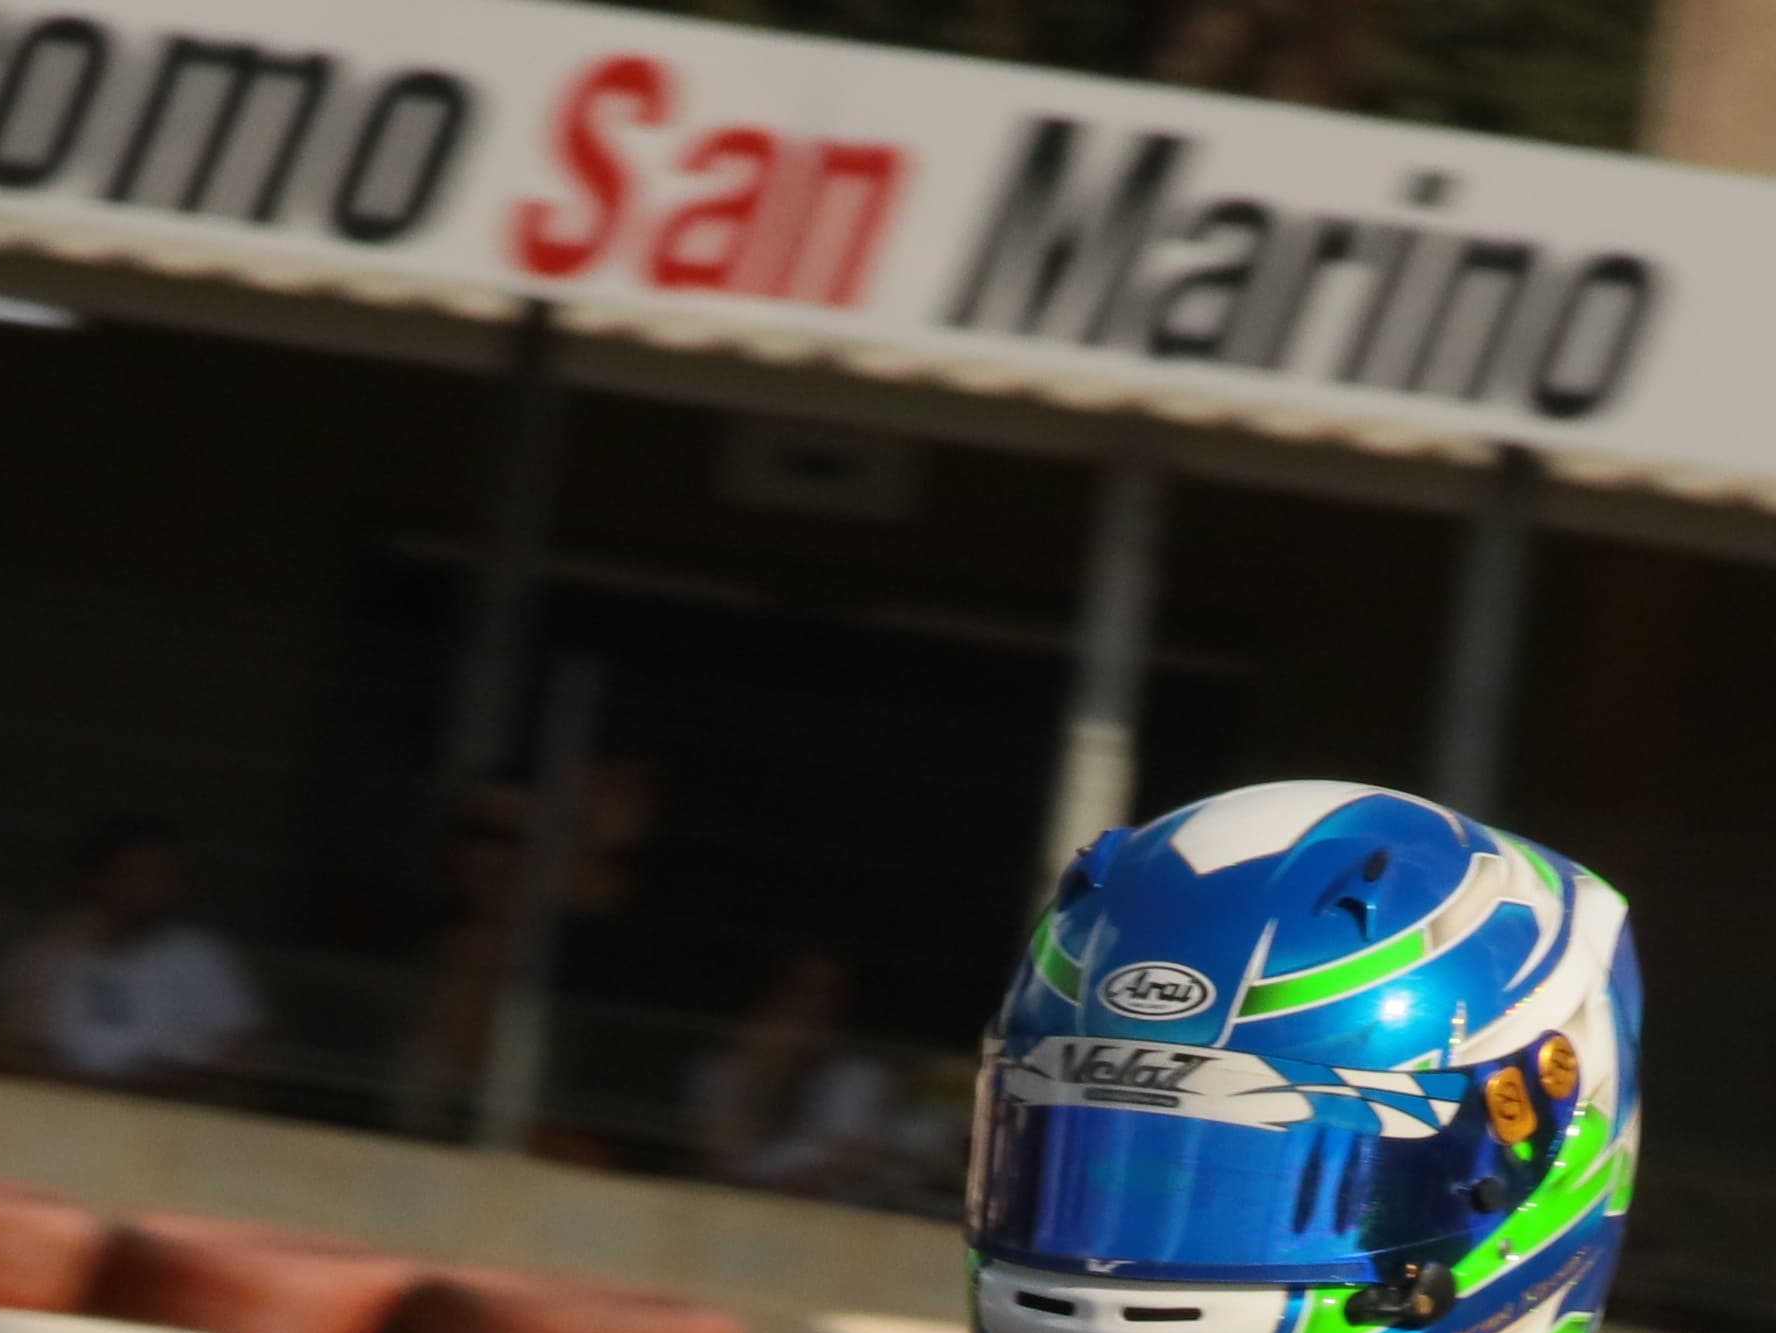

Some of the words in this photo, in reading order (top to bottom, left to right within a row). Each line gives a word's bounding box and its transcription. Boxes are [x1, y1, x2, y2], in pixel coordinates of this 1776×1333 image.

[509, 52, 914, 312] San
[940, 114, 1664, 420] Marino
[1106, 968, 1200, 1002] Arai
